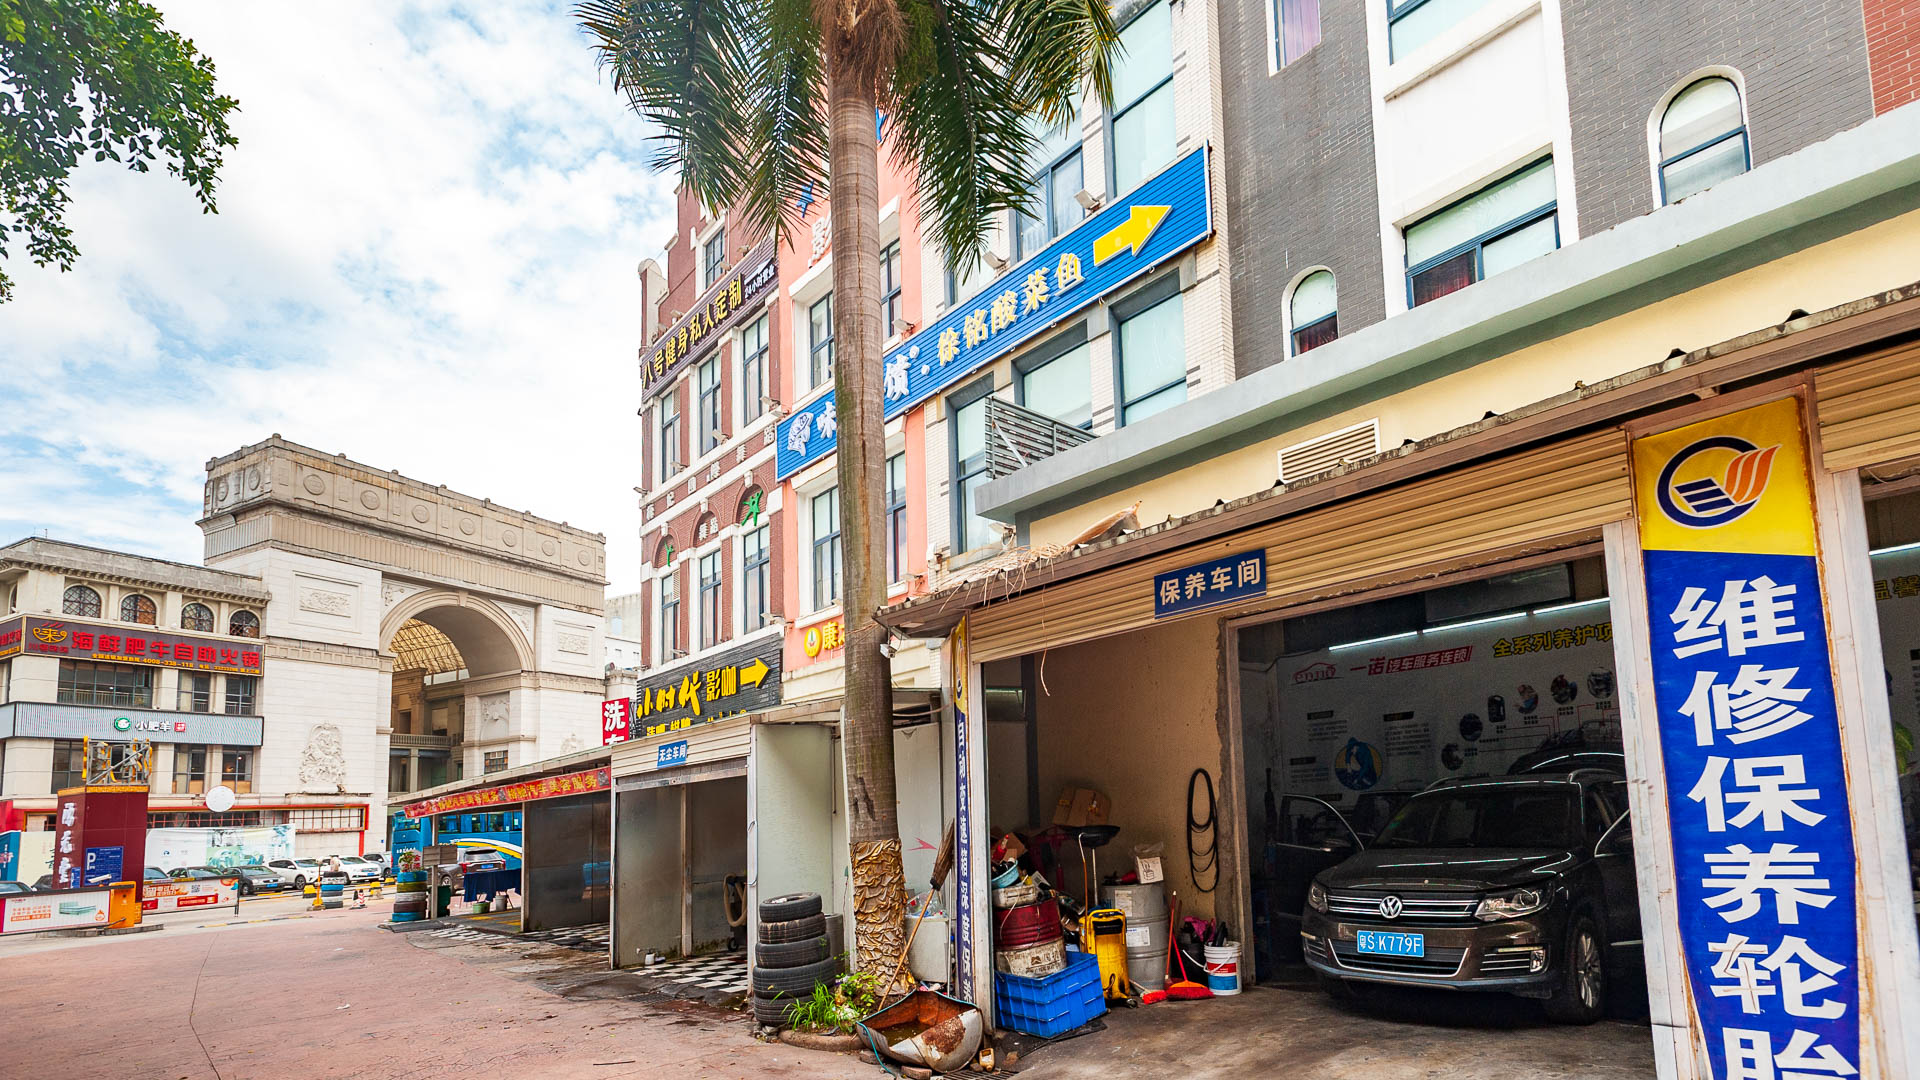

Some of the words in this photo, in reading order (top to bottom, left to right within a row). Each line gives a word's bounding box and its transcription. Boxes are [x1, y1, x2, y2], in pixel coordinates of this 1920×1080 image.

[642, 272, 742, 389] 八号健身私人定制
[937, 253, 1086, 366] 徐铭酸菜鱼
[1160, 558, 1260, 606] 保养车间
[72, 631, 260, 668] 海鲜肥牛自助火锅
[135, 720, 172, 732] 小肥羊
[658, 744, 687, 762] 无尘车间
[1669, 575, 1858, 1080] 维修保养轮胎
[86, 852, 96, 871] P
